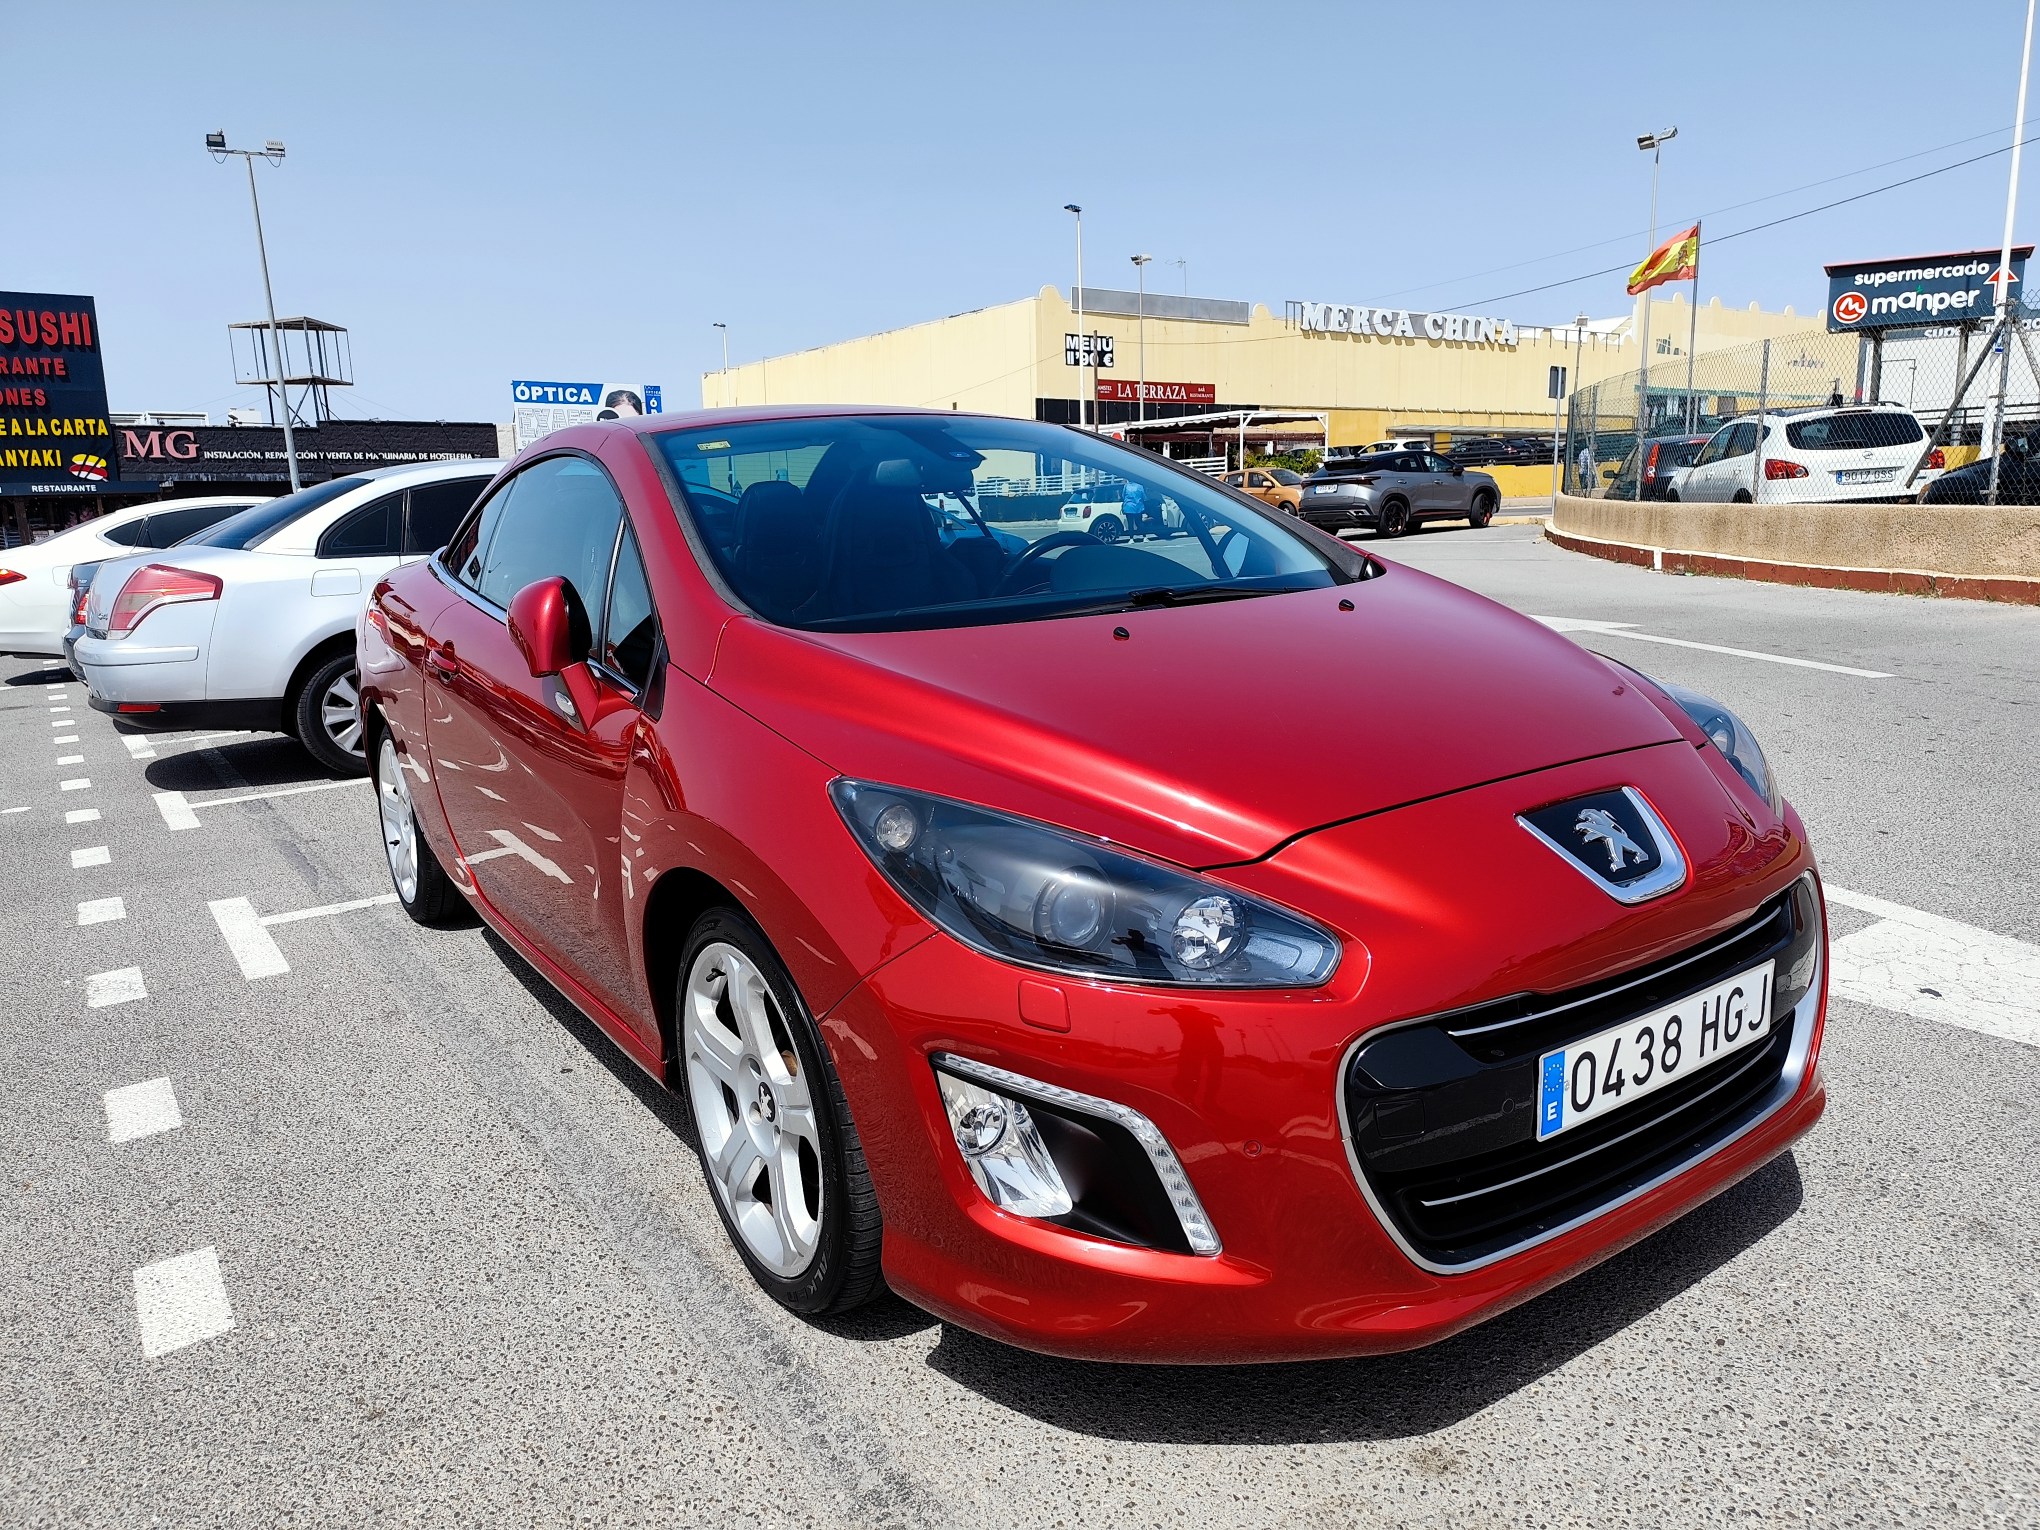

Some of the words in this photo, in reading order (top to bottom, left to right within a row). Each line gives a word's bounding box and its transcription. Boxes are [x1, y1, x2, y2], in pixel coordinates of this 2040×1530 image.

[1854, 260, 1990, 287] supermercado
[1871, 289, 1980, 315] manper
[0, 309, 92, 346] SUSHI
[1300, 302, 1415, 338] MERCA
[1424, 312, 1518, 346] CHINA
[1066, 336, 1113, 351] MENÚ
[1103, 353, 1113, 367] €
[515, 383, 593, 403] ÓPTICA
[1117, 383, 1132, 397] LA
[1134, 384, 1187, 399] TERRAZA
[11, 418, 23, 436] A
[25, 418, 48, 436] LA
[50, 419, 109, 436] CARTA
[121, 430, 200, 459] MG
[204, 450, 263, 460] INSTALACIÓN,
[265, 450, 317, 460] REPARCIÓN
[326, 452, 352, 460] VENTA
[354, 452, 363, 460] DE
[1844, 471, 1870, 481] 9017
[31, 484, 97, 493] RESTAURANTE
[1547, 1101, 1557, 1121] E
[1571, 1015, 1682, 1112] 0438
[1699, 974, 1768, 1058] HGJ
